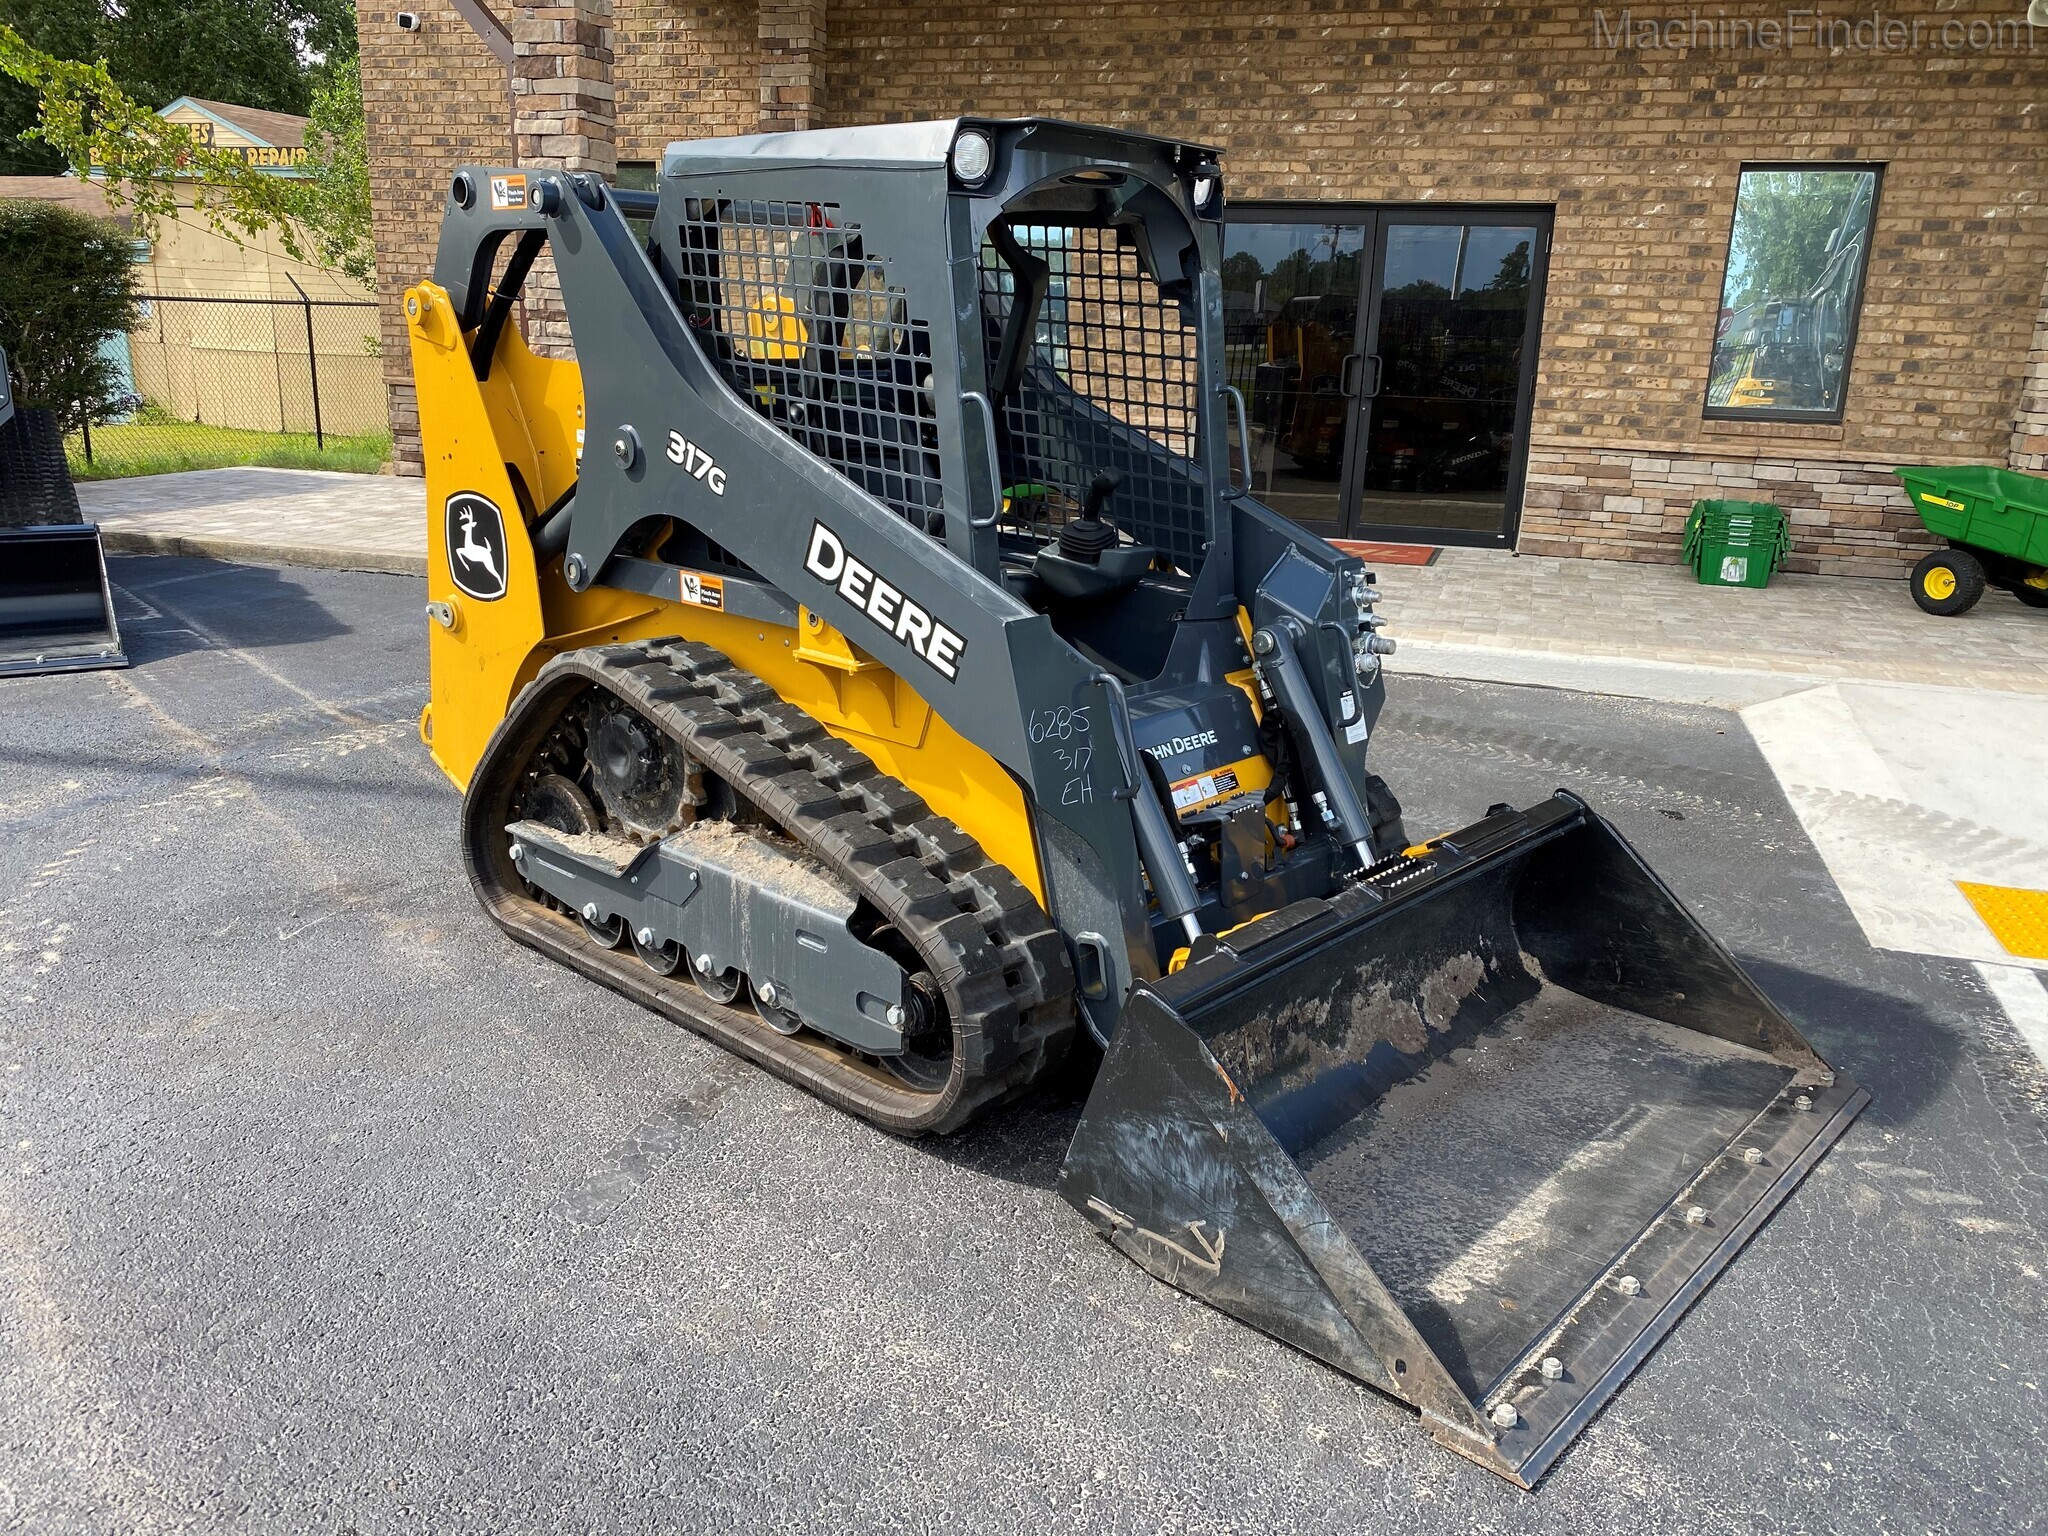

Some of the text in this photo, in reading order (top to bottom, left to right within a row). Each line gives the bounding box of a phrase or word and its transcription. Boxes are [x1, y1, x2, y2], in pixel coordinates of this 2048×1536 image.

[666, 430, 727, 496] 317G
[1451, 449, 1491, 466] HONDA
[805, 521, 965, 680] DEERE
[1028, 705, 1091, 743] 6285
[1172, 730, 1218, 754] DEERE
